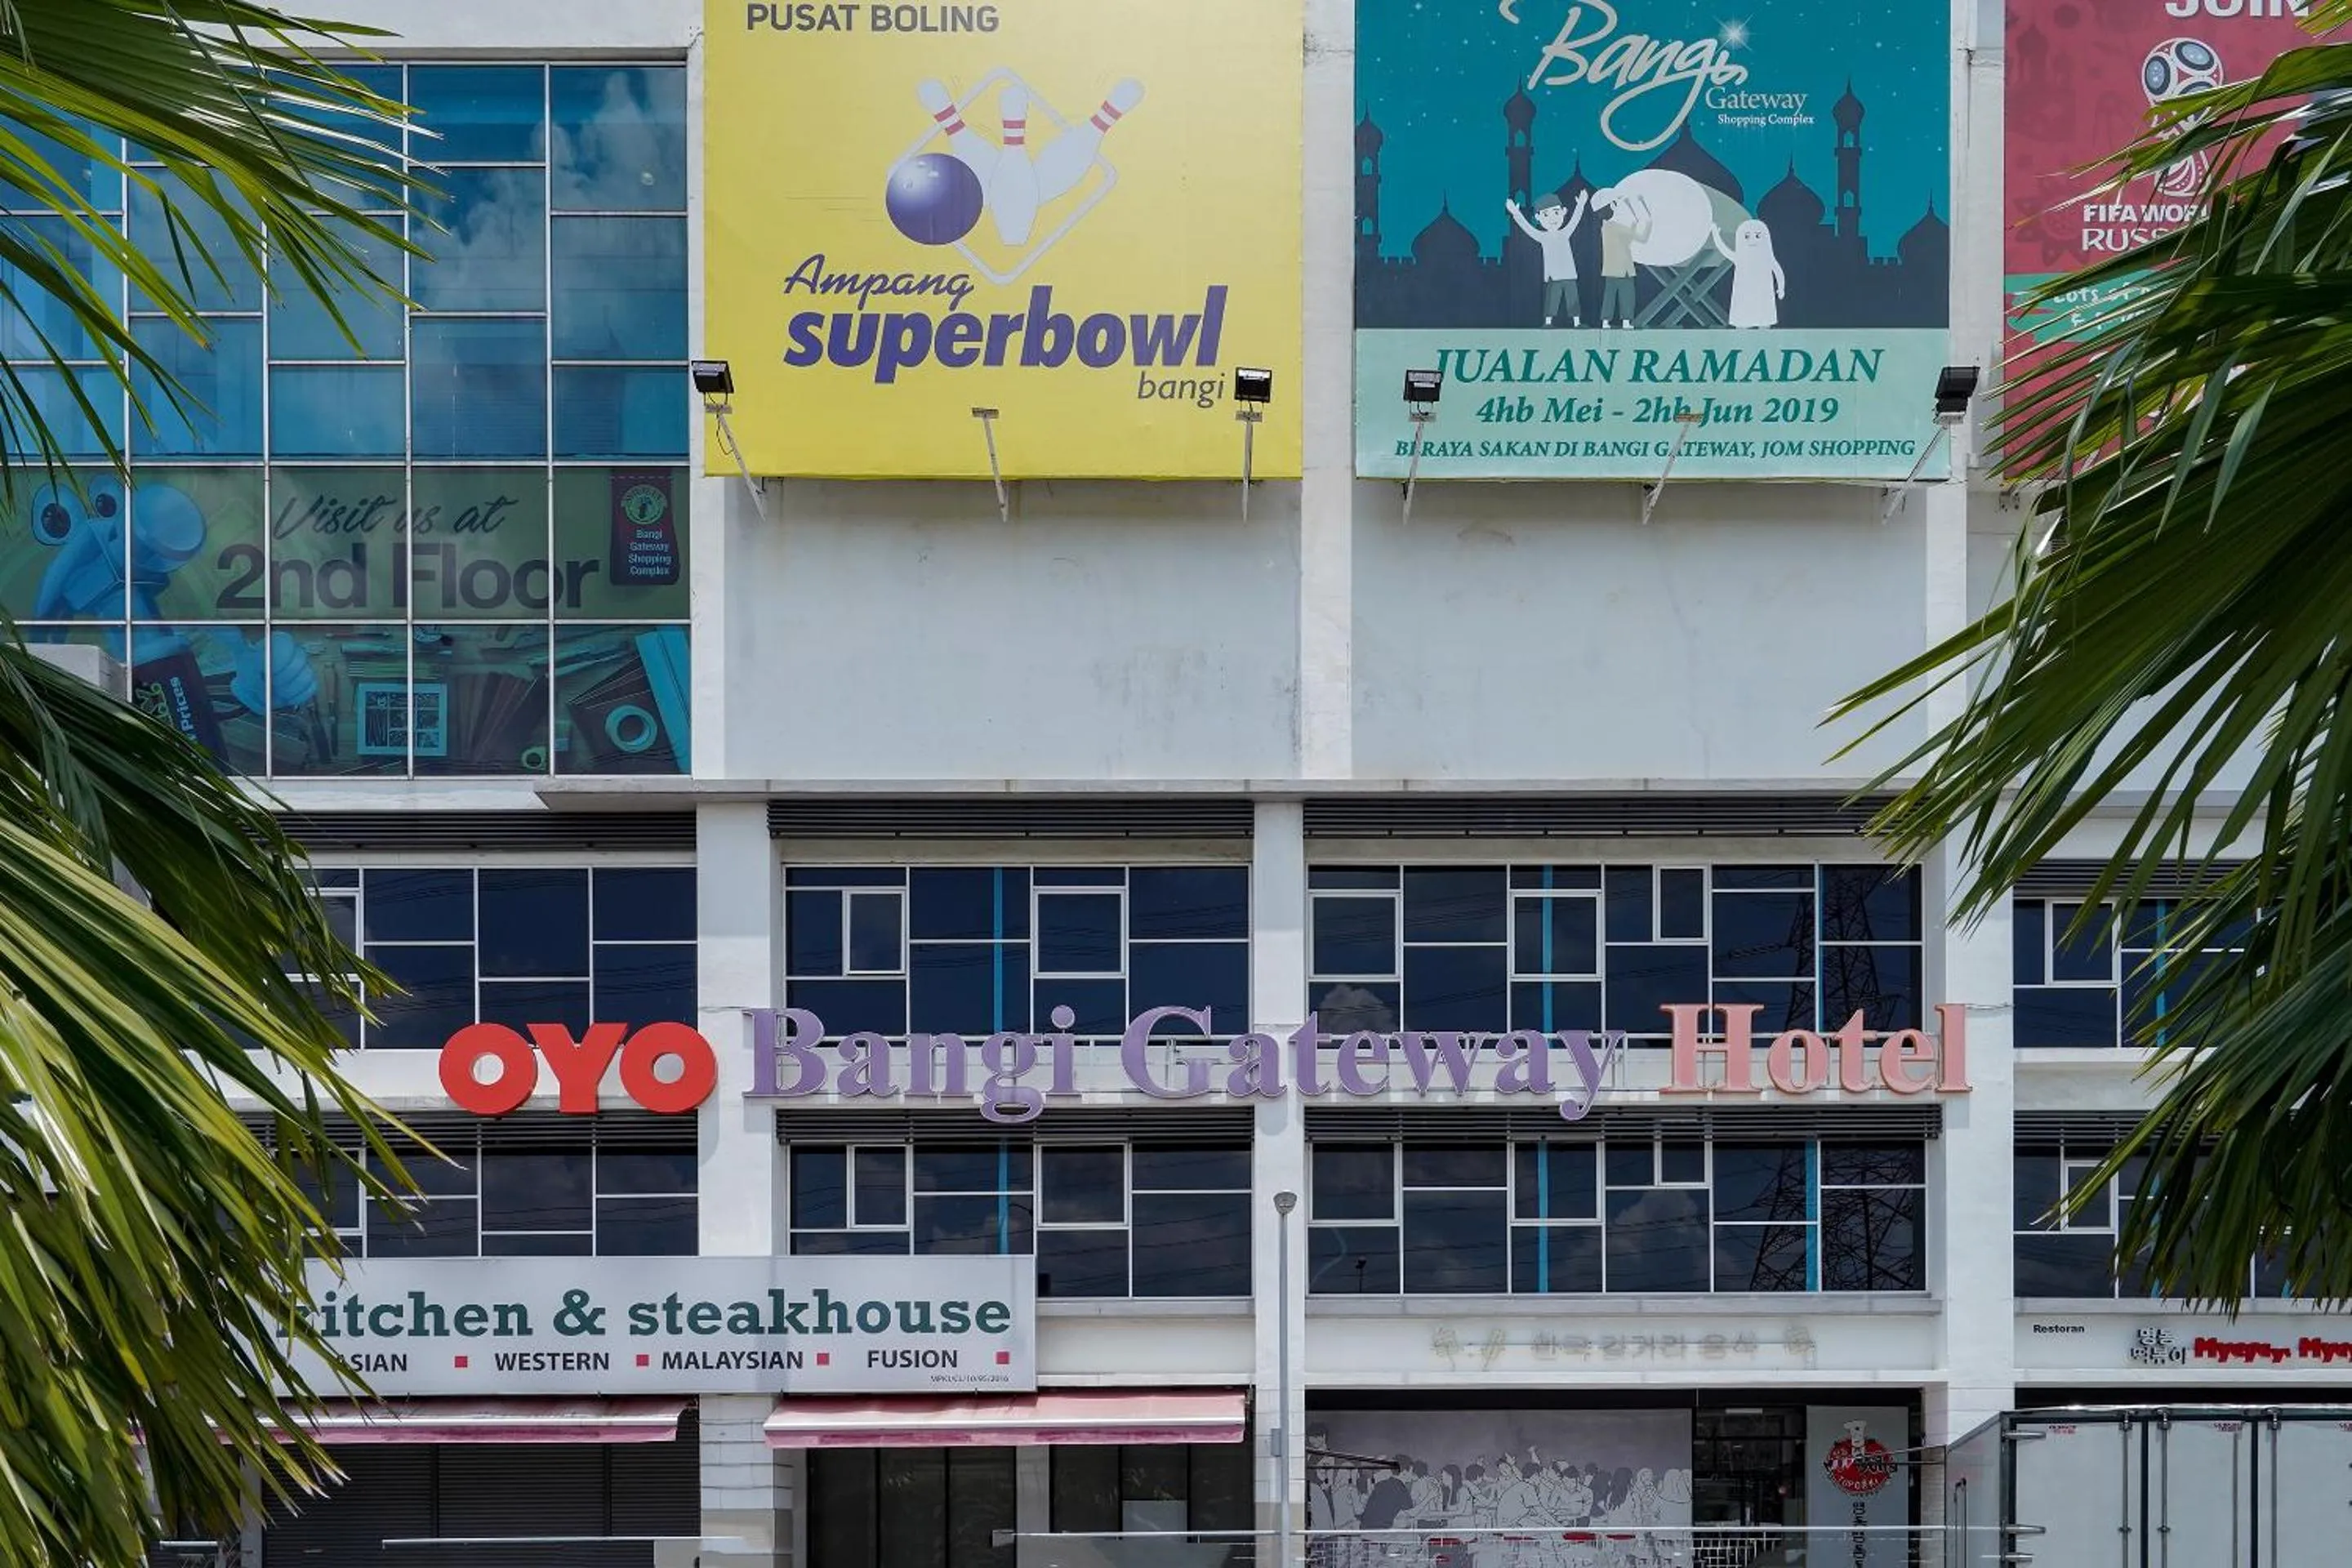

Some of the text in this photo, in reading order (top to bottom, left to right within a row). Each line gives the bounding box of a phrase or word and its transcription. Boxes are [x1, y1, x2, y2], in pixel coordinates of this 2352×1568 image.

[746, 3, 1000, 32] PUSAT BOLING
[1705, 87, 1808, 114] Gateway
[1717, 114, 1815, 127] Shopping Complex
[2083, 203, 2137, 222] FIFA
[784, 253, 974, 311] Ampang
[783, 285, 1228, 384] superbowl
[1435, 349, 1885, 383] JUALAN RAMADAN
[1137, 372, 1225, 408] bangi
[1476, 396, 1534, 423] 4hb
[1543, 397, 1604, 423] Mei
[1698, 397, 1753, 428] Jun
[1762, 396, 1839, 423] 2019
[1479, 441, 1551, 457] SAKAN
[1554, 441, 1579, 457] DI
[1582, 441, 1650, 457] BANGI
[1654, 441, 1756, 458] GTEWAY,
[1761, 440, 1804, 458] JOM
[1809, 440, 1915, 456] SHOPPING
[274, 493, 519, 540] Visit us at
[216, 543, 601, 609] 2nd Floor
[627, 555, 671, 565] Shopping
[439, 1003, 1973, 1124] OYO Bangi Gateway Hotel
[552, 1288, 610, 1338] &
[629, 1288, 1011, 1337] steakhouse
[2033, 1324, 2085, 1334] Restoran
[494, 1352, 610, 1372] WESTERN
[662, 1350, 804, 1370] MALAYSIAN
[866, 1349, 958, 1369] FUSION
